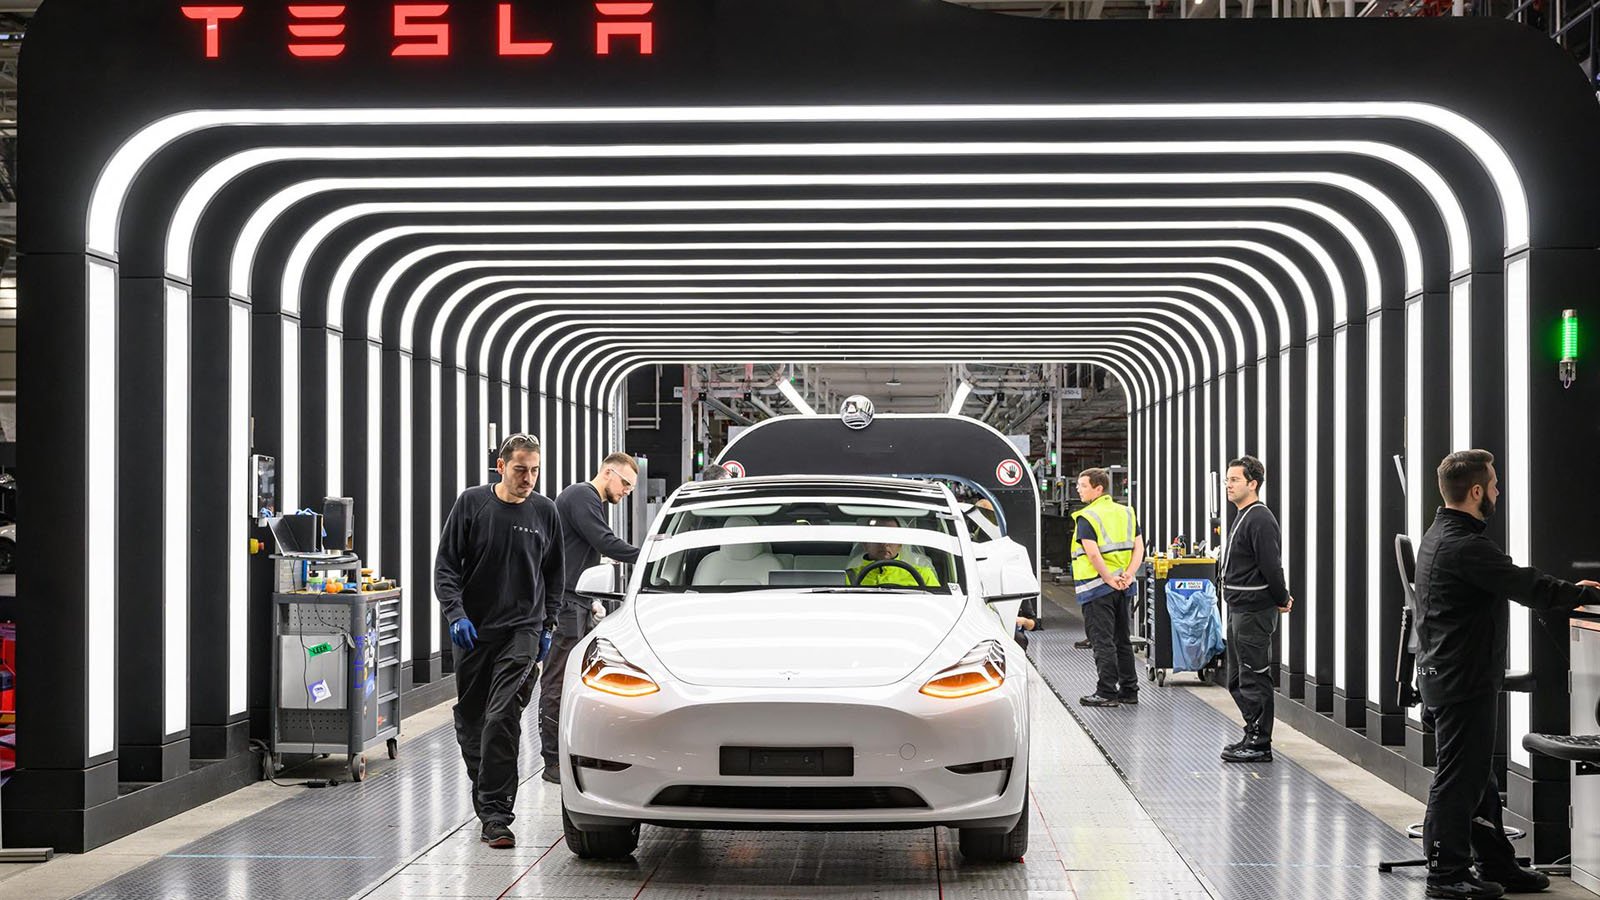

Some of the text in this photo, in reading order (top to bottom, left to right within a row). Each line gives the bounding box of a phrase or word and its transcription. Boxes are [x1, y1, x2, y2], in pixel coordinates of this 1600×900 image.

[181, 3, 653, 57] TESLA
[513, 525, 539, 534] TESLA
[1431, 840, 1440, 868] SLA
